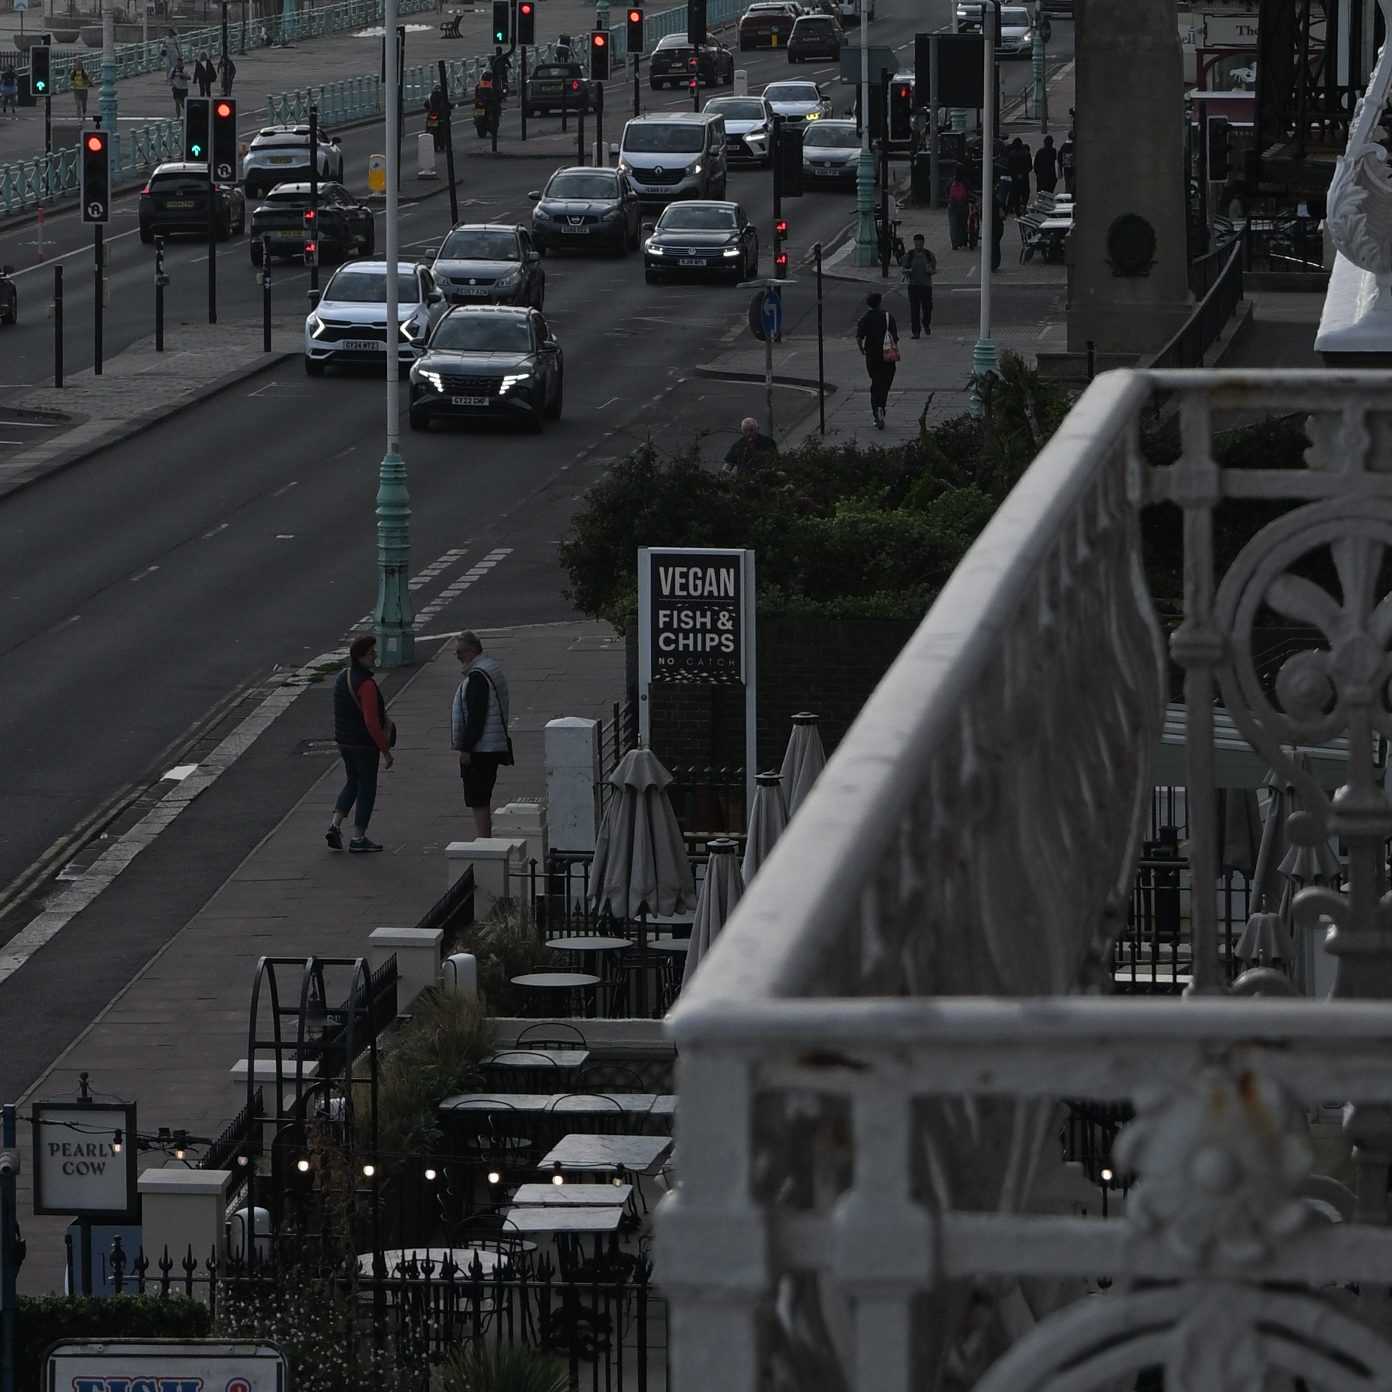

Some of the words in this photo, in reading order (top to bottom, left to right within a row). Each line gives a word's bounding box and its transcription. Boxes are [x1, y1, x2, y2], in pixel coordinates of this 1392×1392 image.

[659, 566, 735, 597] VEGAN
[658, 610, 711, 629] FISH
[717, 611, 734, 630] &
[658, 632, 735, 653] CHIPS
[659, 658, 675, 666] NO
[686, 658, 735, 667] CATCH
[48, 1142, 119, 1158] PEARLY
[62, 1161, 106, 1176] COW
